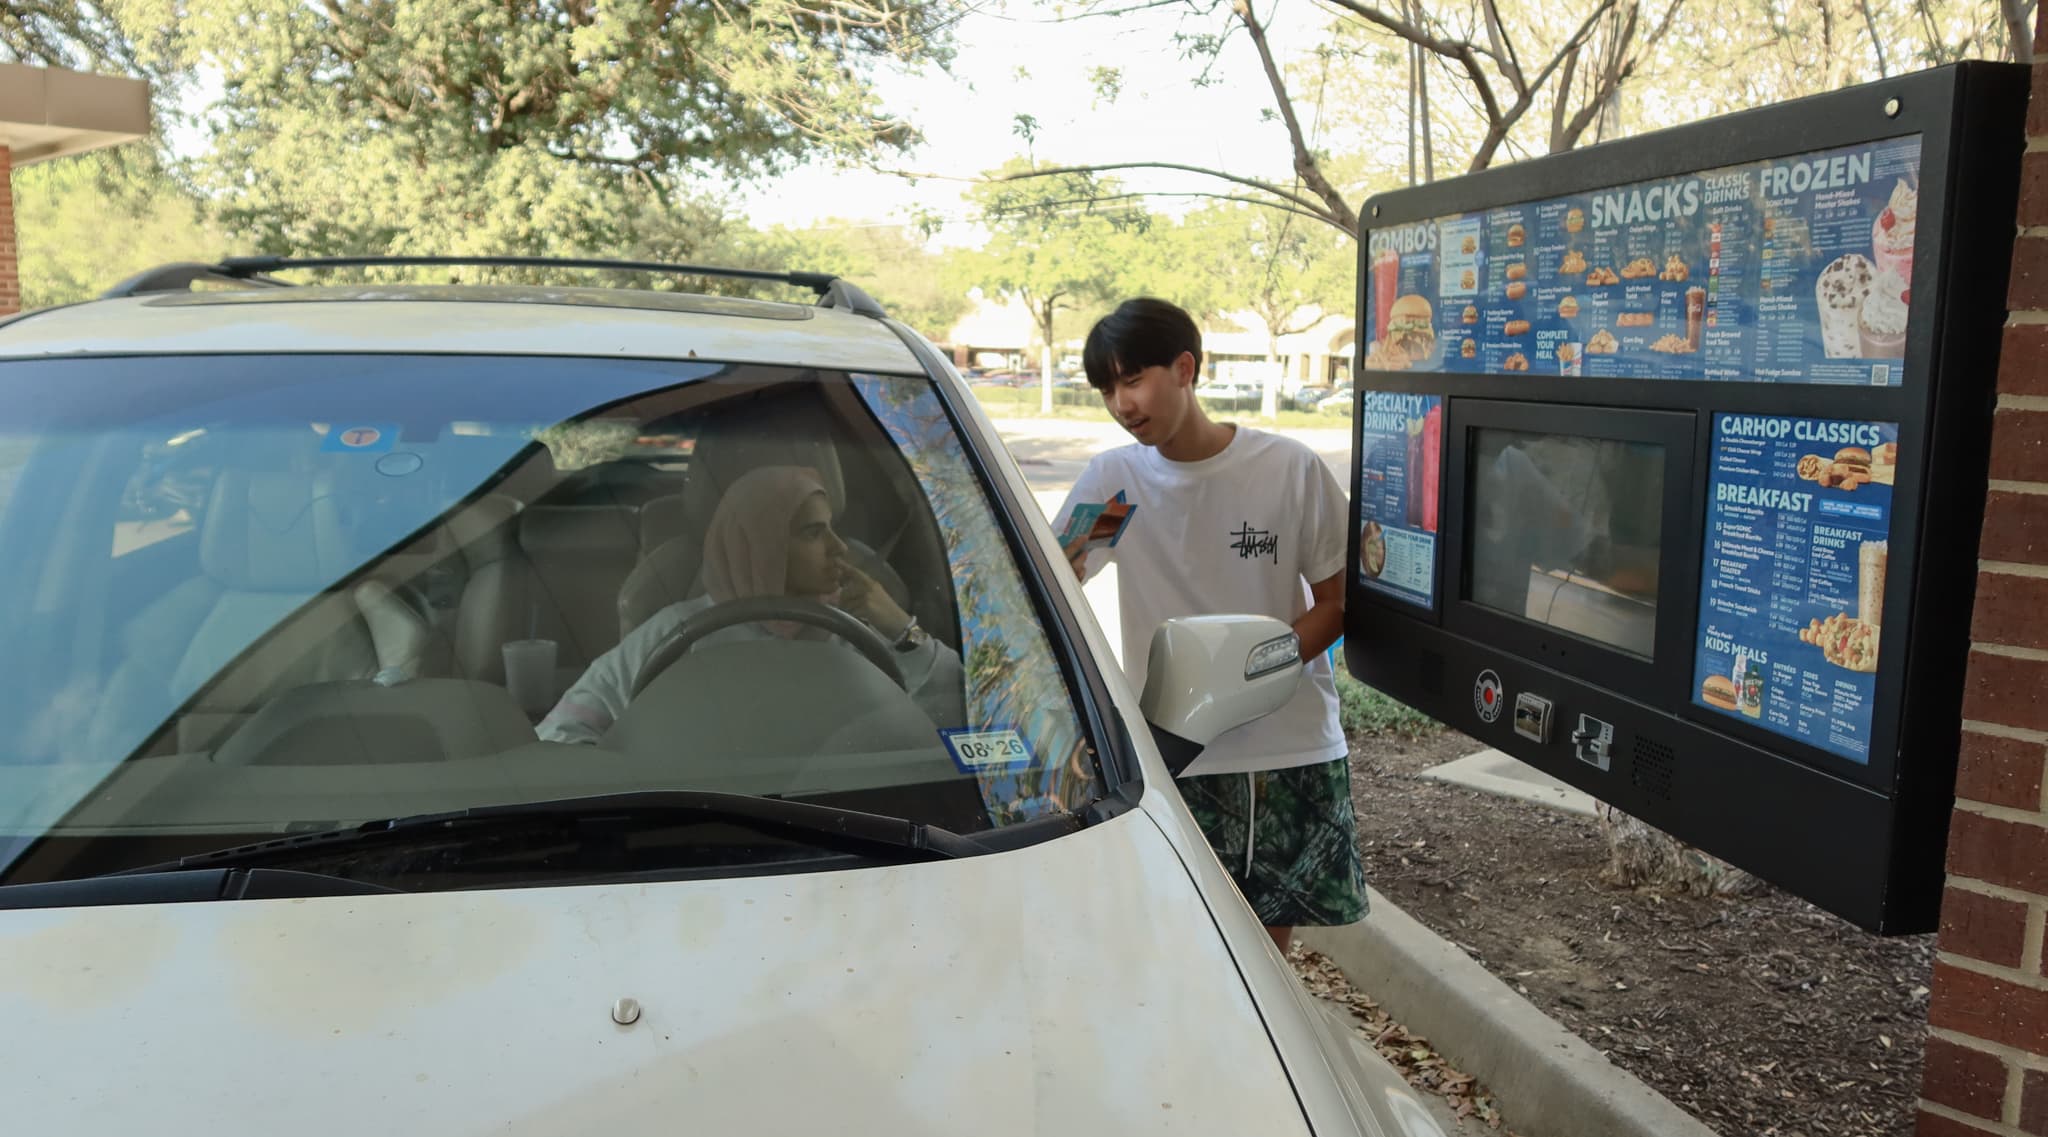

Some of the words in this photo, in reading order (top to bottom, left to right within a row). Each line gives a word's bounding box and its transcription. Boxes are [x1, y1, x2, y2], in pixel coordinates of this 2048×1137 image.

[1705, 172, 1750, 190] CLASSIC
[1759, 152, 1871, 198] FROZEN
[1591, 180, 1699, 228] SNACKS
[1704, 186, 1750, 204] DRINKS
[1369, 223, 1437, 257] COMBOS
[1536, 330, 1568, 339] COMPLETE
[1536, 340, 1555, 349] YOUR
[1536, 350, 1554, 360] MEAL
[1364, 391, 1423, 415] SPECIALTY
[1364, 412, 1405, 432] DRINKS
[1720, 416, 1791, 439] CARHOP
[1794, 421, 1880, 446] CLASSICS
[1717, 482, 1813, 513] BREAKFAST
[1813, 535, 1846, 549] DRINKS
[1814, 525, 1863, 541] BREAKFAST
[1705, 636, 1730, 654] KIDS
[1731, 643, 1768, 664] MEALS
[960, 742, 989, 759] 08
[995, 739, 1024, 755] 26
